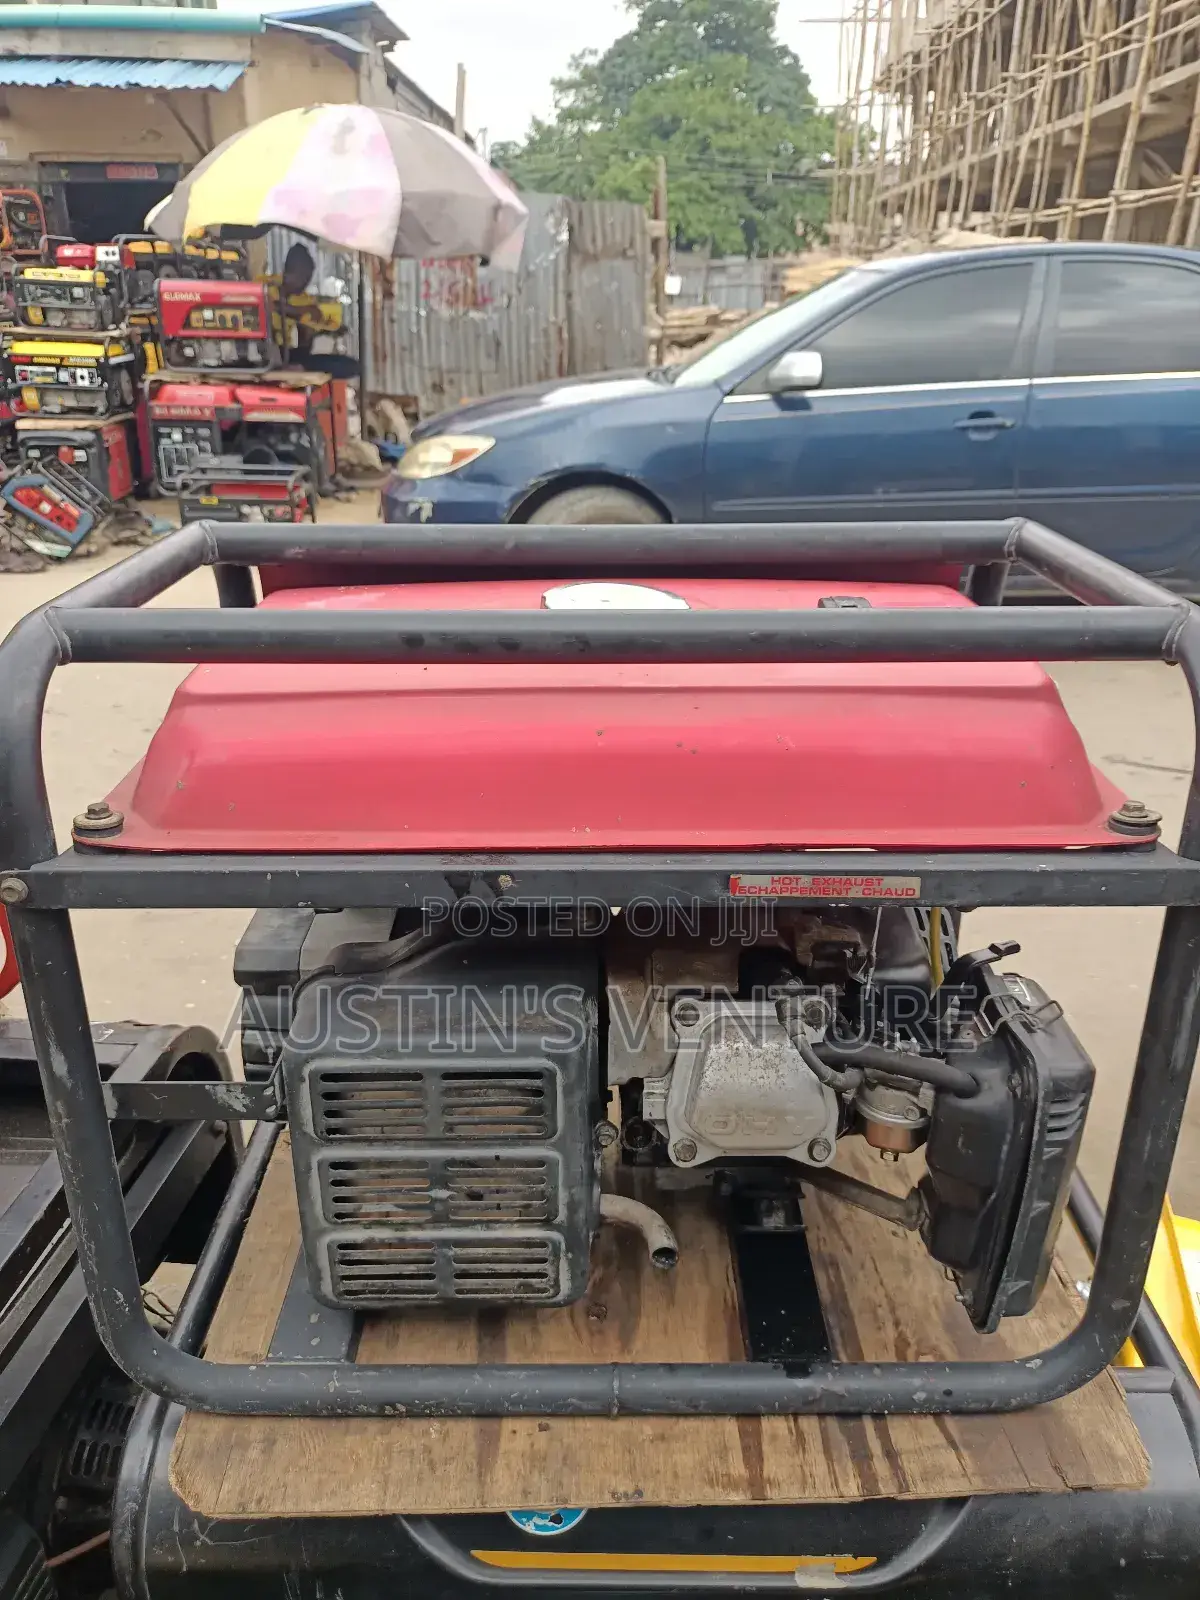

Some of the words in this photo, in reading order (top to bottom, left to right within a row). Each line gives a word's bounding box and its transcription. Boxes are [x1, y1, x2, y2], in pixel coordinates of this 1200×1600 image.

[771, 876, 802, 886] HOT
[811, 877, 884, 887] EXHAUST
[737, 886, 852, 896] ECHAPPEMENT
[861, 888, 917, 897] CHAUD
